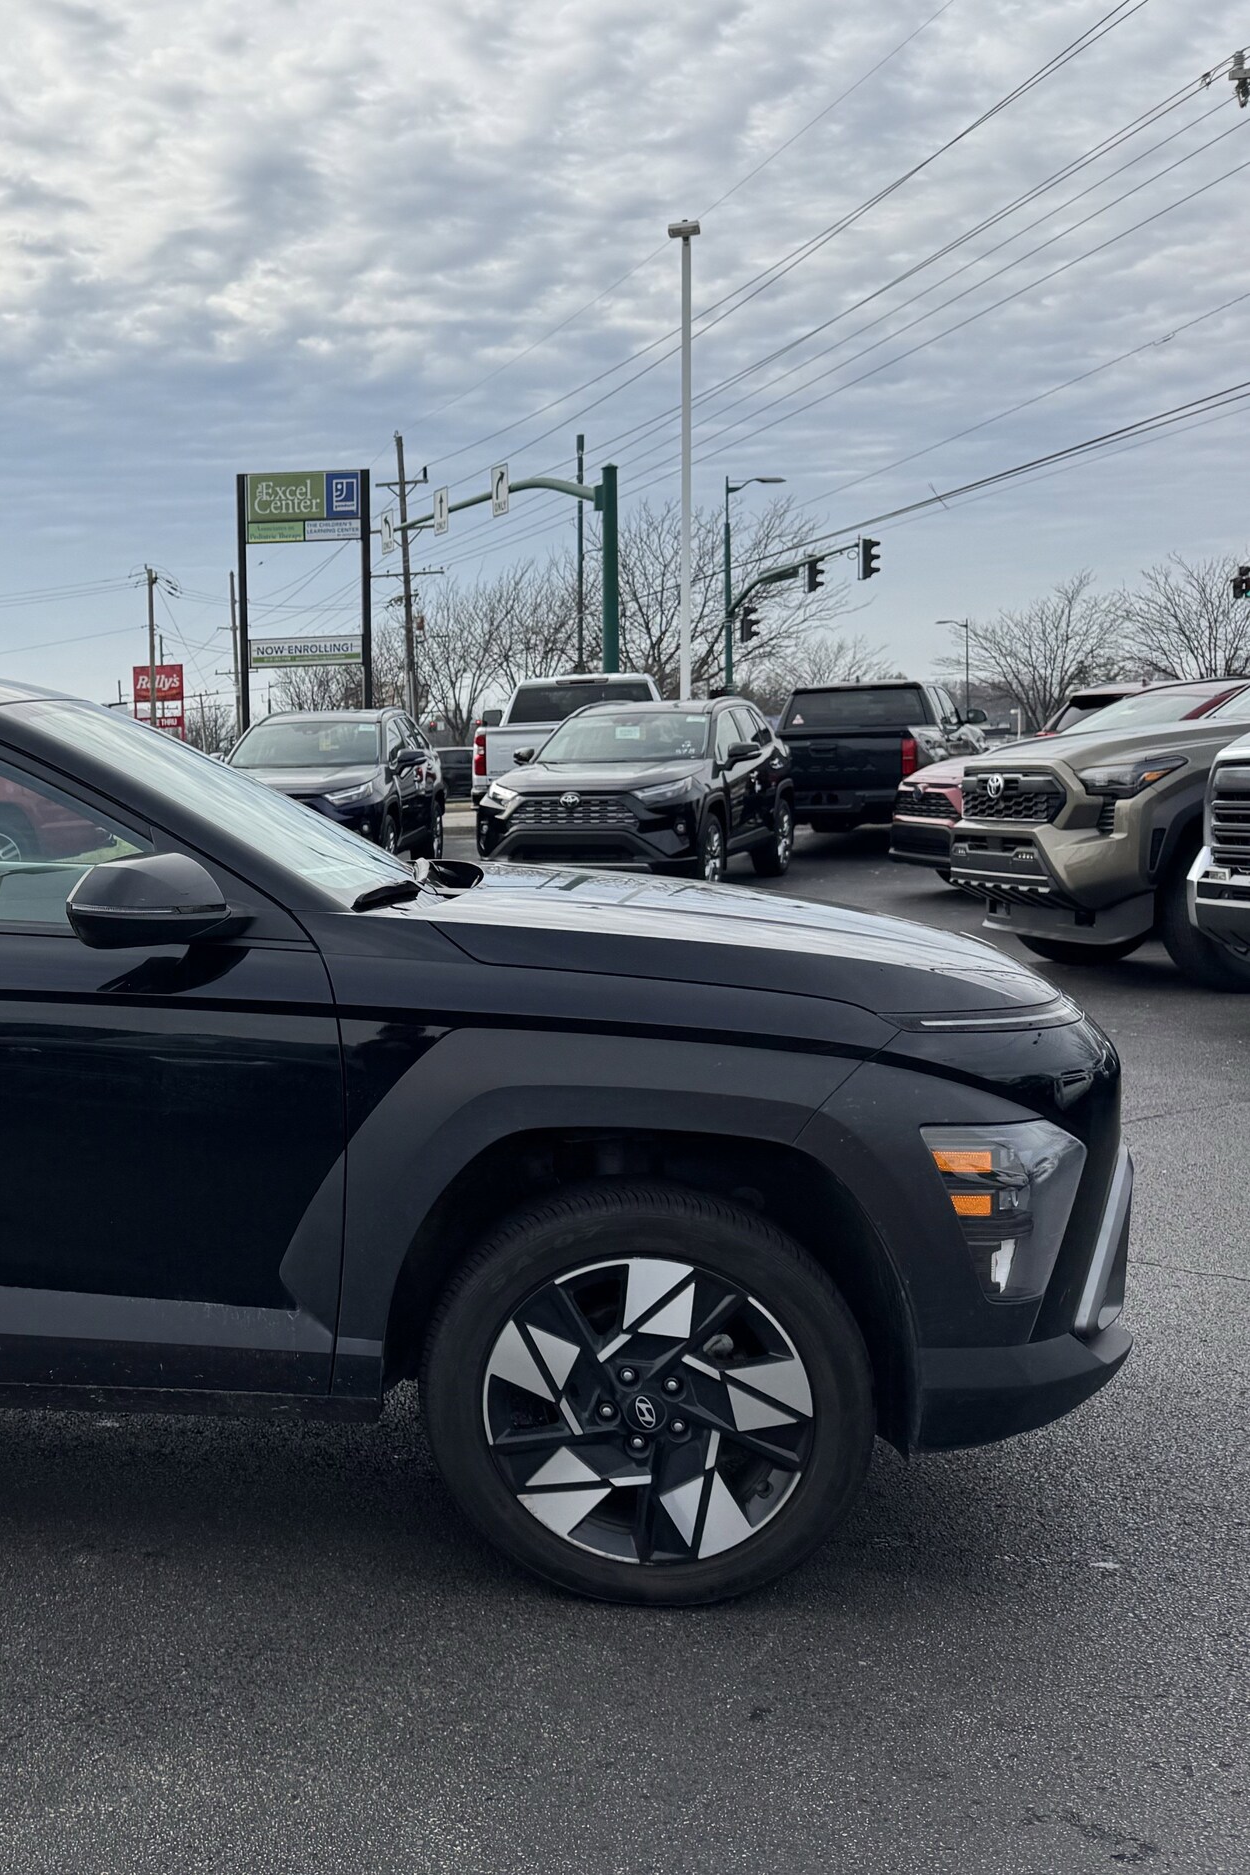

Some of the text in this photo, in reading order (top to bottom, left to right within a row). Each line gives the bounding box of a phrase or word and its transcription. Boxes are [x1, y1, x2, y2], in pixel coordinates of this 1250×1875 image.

[260, 479, 312, 500] Excel
[254, 495, 321, 514] Center
[494, 501, 507, 512] ONLY
[306, 527, 336, 535] LEARNING
[436, 521, 446, 531] ONLY
[256, 643, 353, 656] NOW ENROLLING!
[161, 718, 178, 727] THRU
